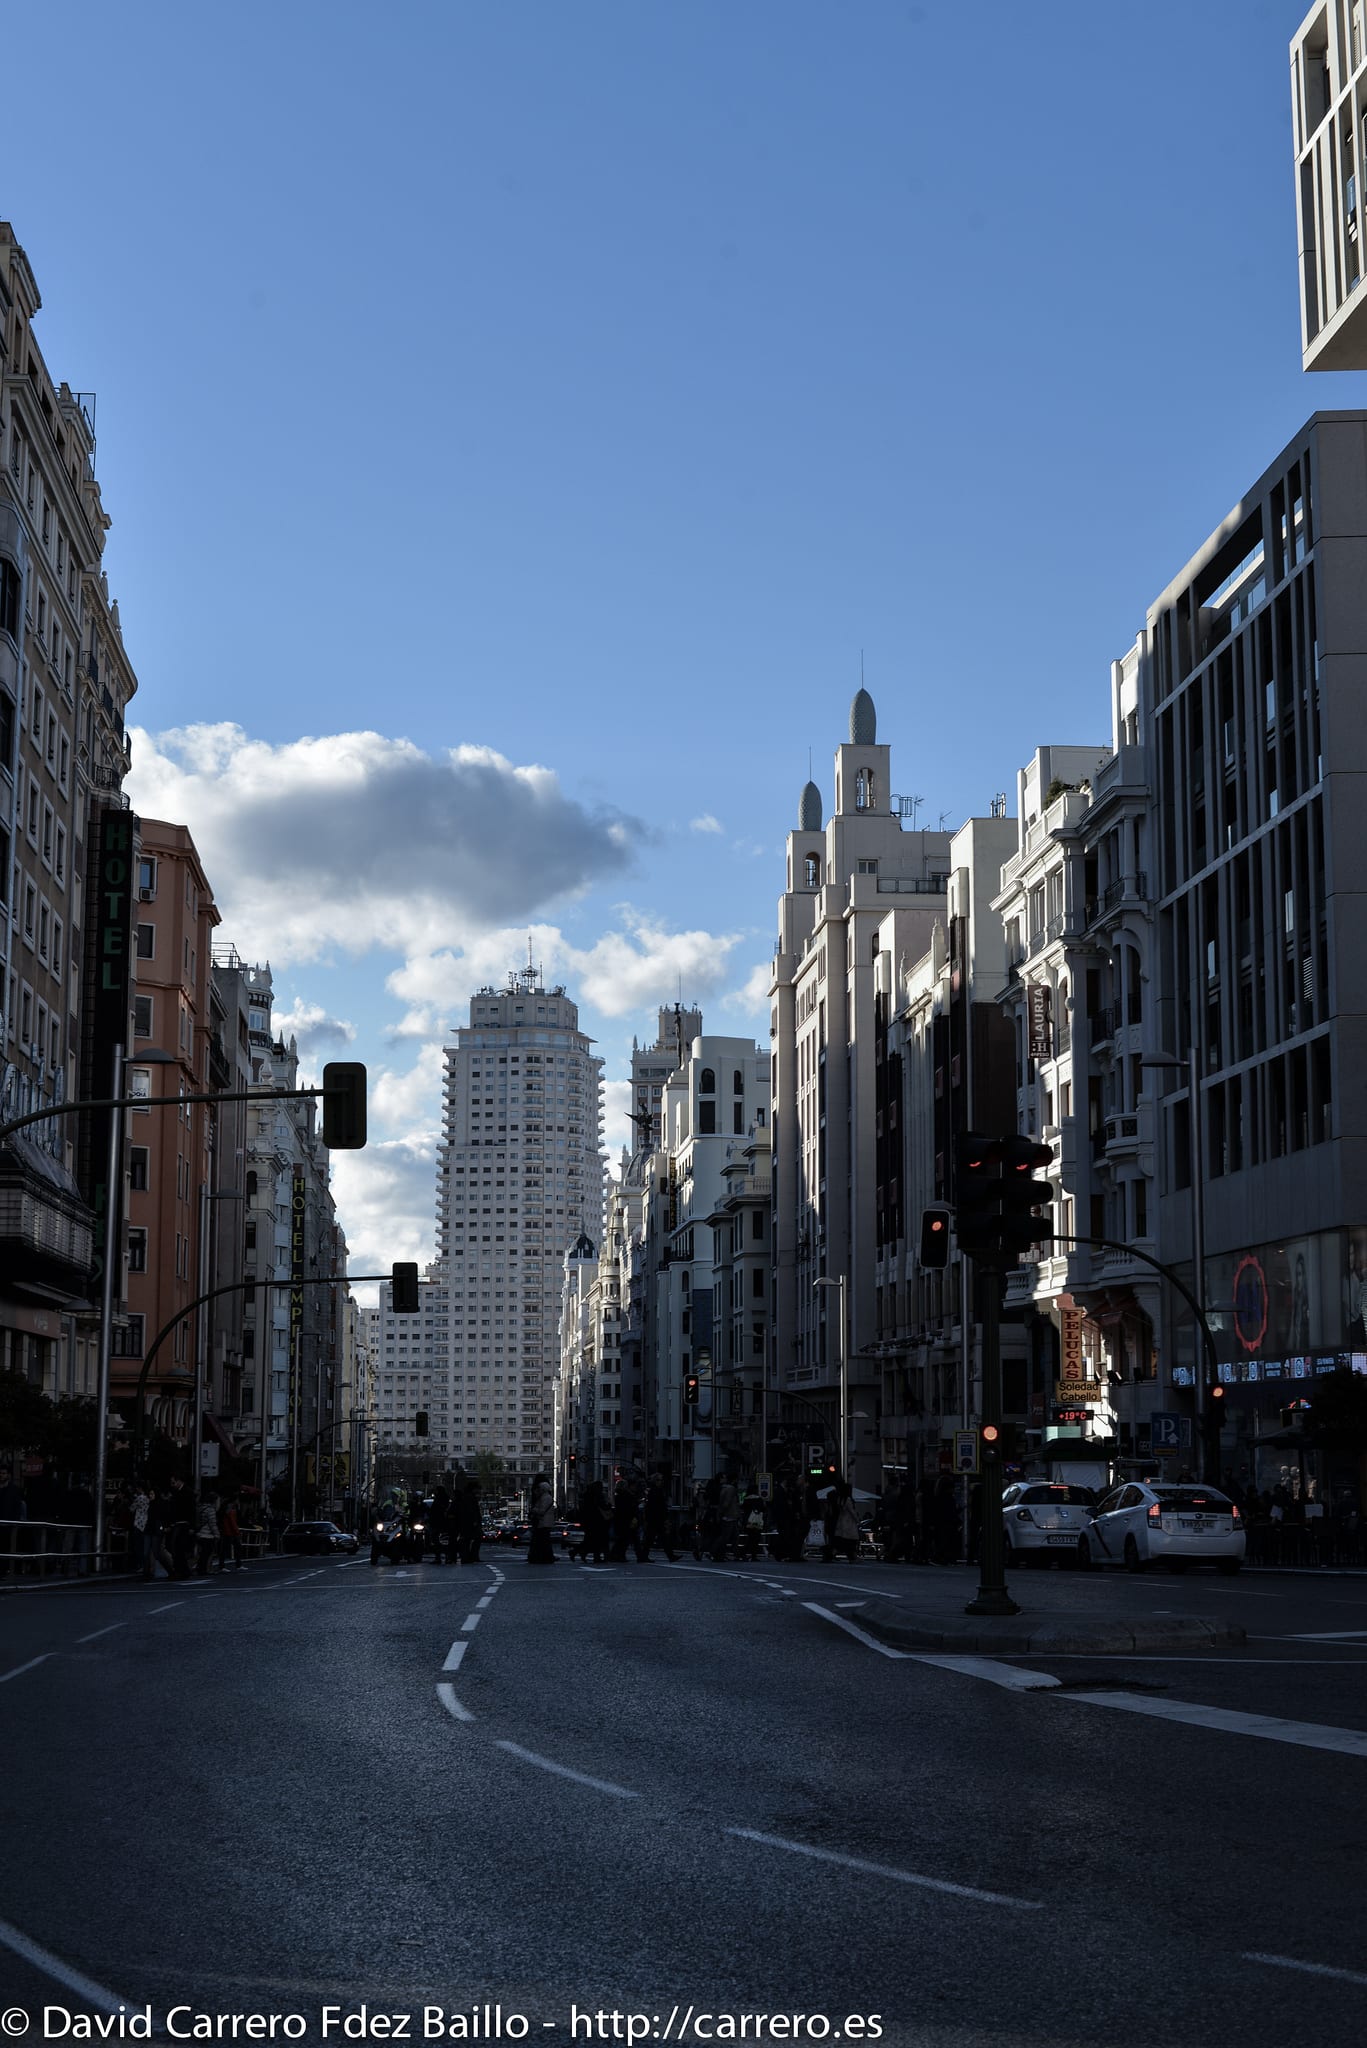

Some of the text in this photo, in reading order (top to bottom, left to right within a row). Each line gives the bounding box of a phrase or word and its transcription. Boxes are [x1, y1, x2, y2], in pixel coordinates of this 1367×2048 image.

[102, 823, 127, 990] HOTEL
[1033, 987, 1045, 1040] LAURIA
[292, 1178, 305, 1263] HOTEL
[1064, 1311, 1080, 1379] PELUCAS
[1058, 1382, 1099, 1391] Soledad
[1060, 1392, 1098, 1402] Cabello
[1160, 1418, 1176, 1442] P
